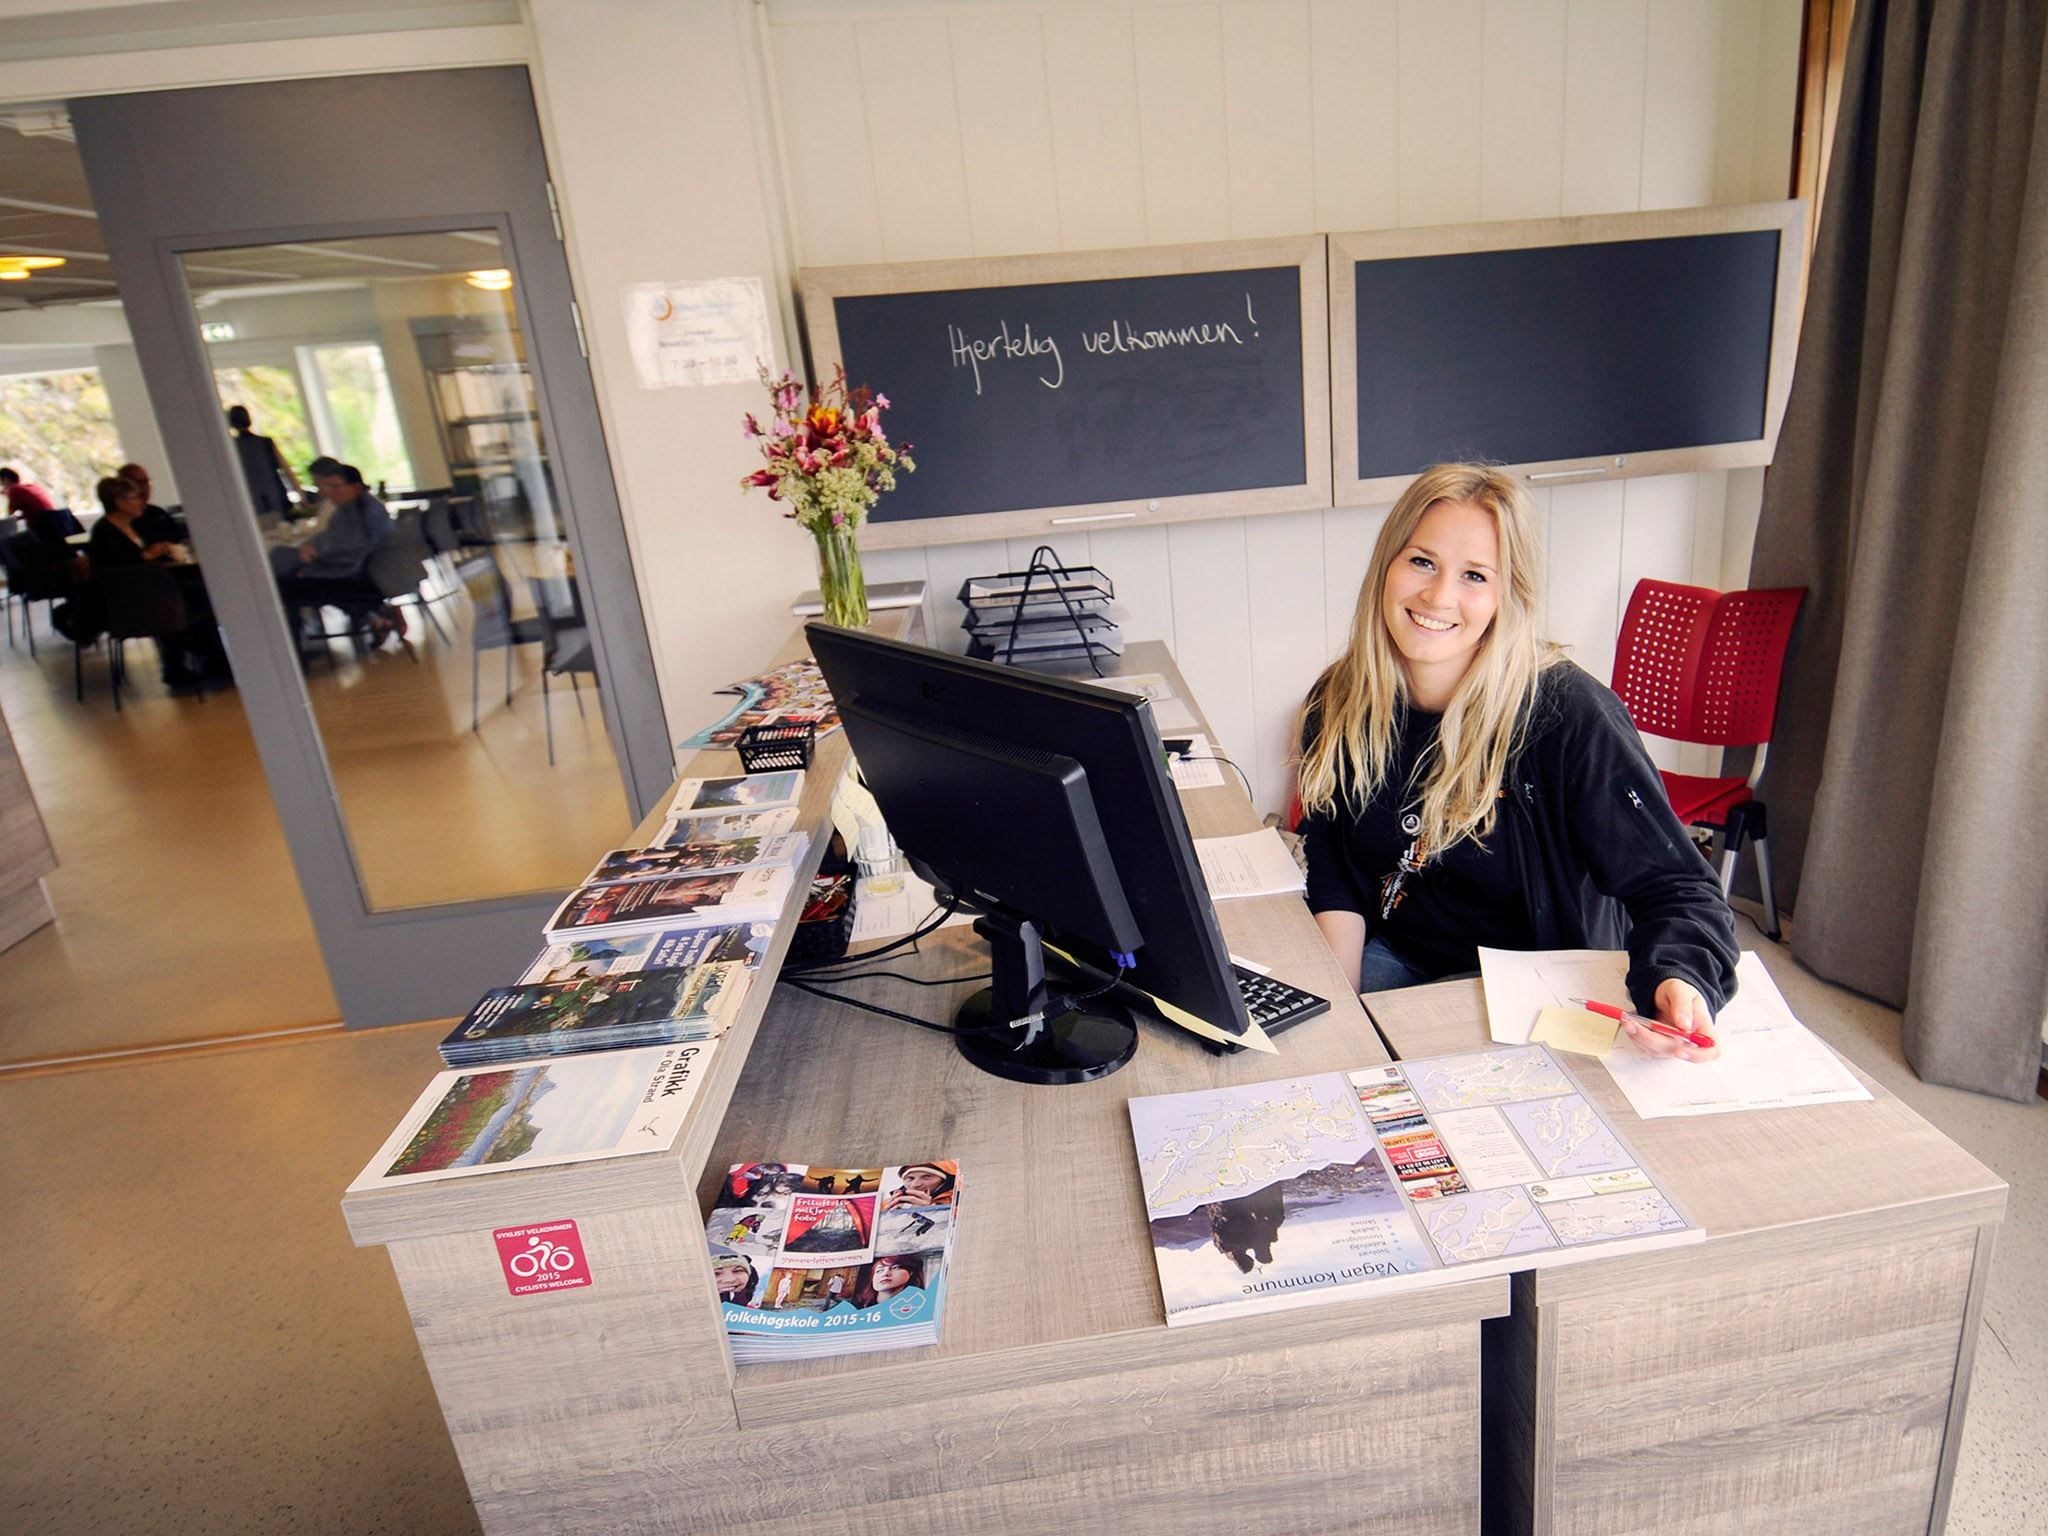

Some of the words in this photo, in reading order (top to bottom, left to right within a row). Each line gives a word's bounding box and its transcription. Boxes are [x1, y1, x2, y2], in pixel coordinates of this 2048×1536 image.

[948, 320, 1064, 395] Hjertelig
[666, 1049, 675, 1057] av
[657, 1059, 672, 1073] Ola
[660, 1047, 700, 1097] Grafikk
[642, 1074, 665, 1103] Strand
[793, 1214, 817, 1222] foto
[496, 1229, 525, 1240] SYKLIST
[526, 1223, 573, 1235] VELKOMMEN
[536, 1271, 560, 1282] 2015
[1340, 1262, 1399, 1279] Vågan
[515, 1283, 548, 1293] CYCLISTS
[548, 1277, 585, 1288] WELCOME
[1241, 1271, 1336, 1296] kommune
[724, 1309, 819, 1329] folkehøgskole
